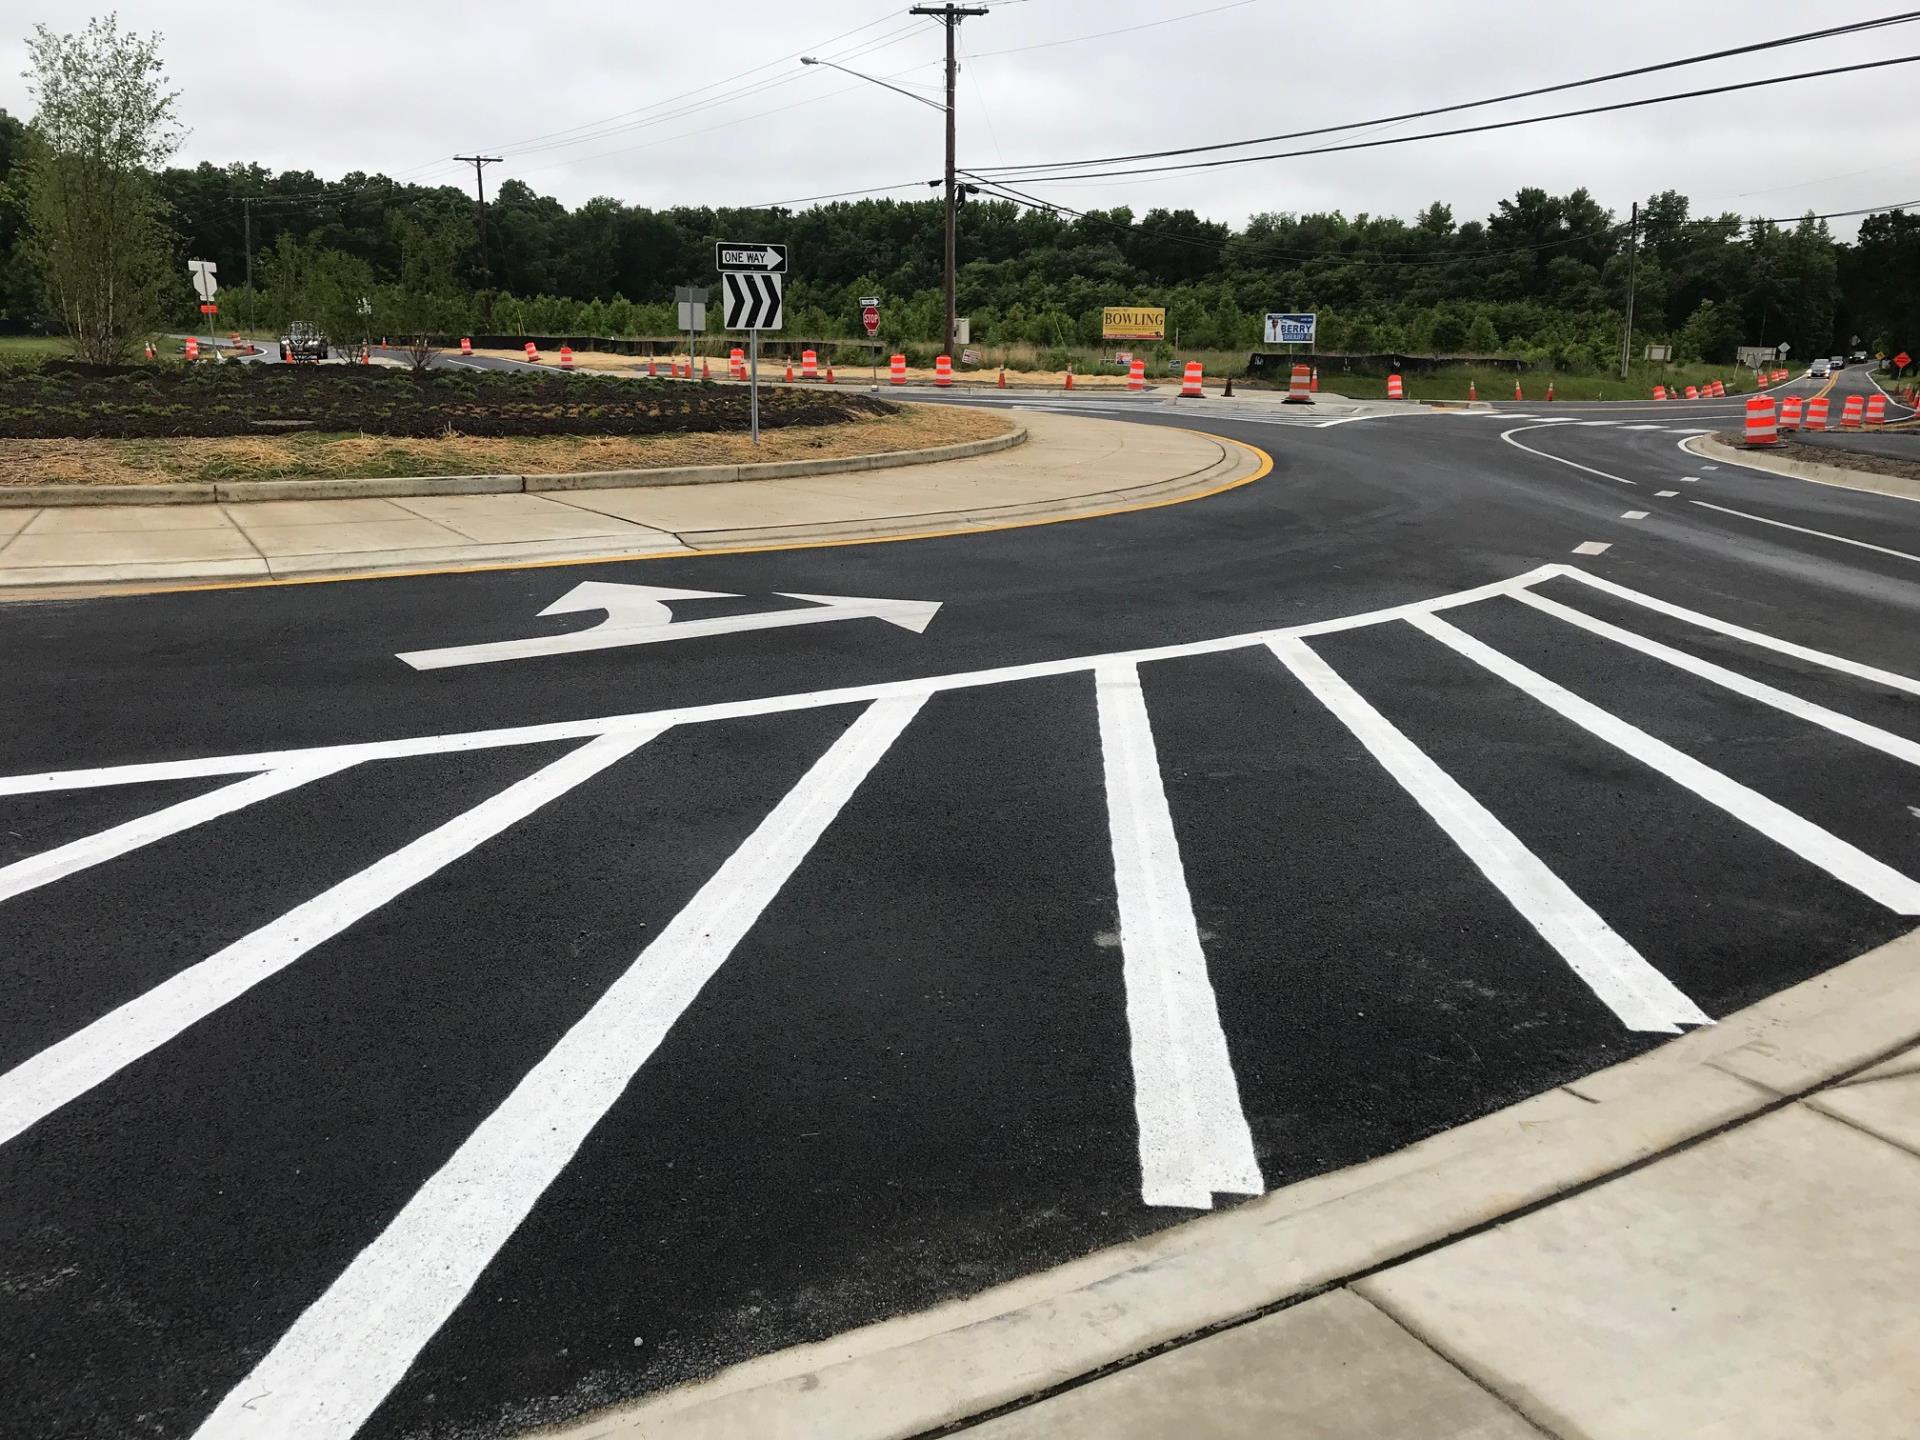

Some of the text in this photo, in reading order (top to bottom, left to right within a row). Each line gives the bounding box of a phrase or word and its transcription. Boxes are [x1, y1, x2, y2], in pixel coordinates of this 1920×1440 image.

[724, 251, 766, 264] ONE WAY
[864, 314, 878, 323] STOP
[1105, 312, 1163, 325] BOWLING
[1281, 324, 1312, 332] BERRY
